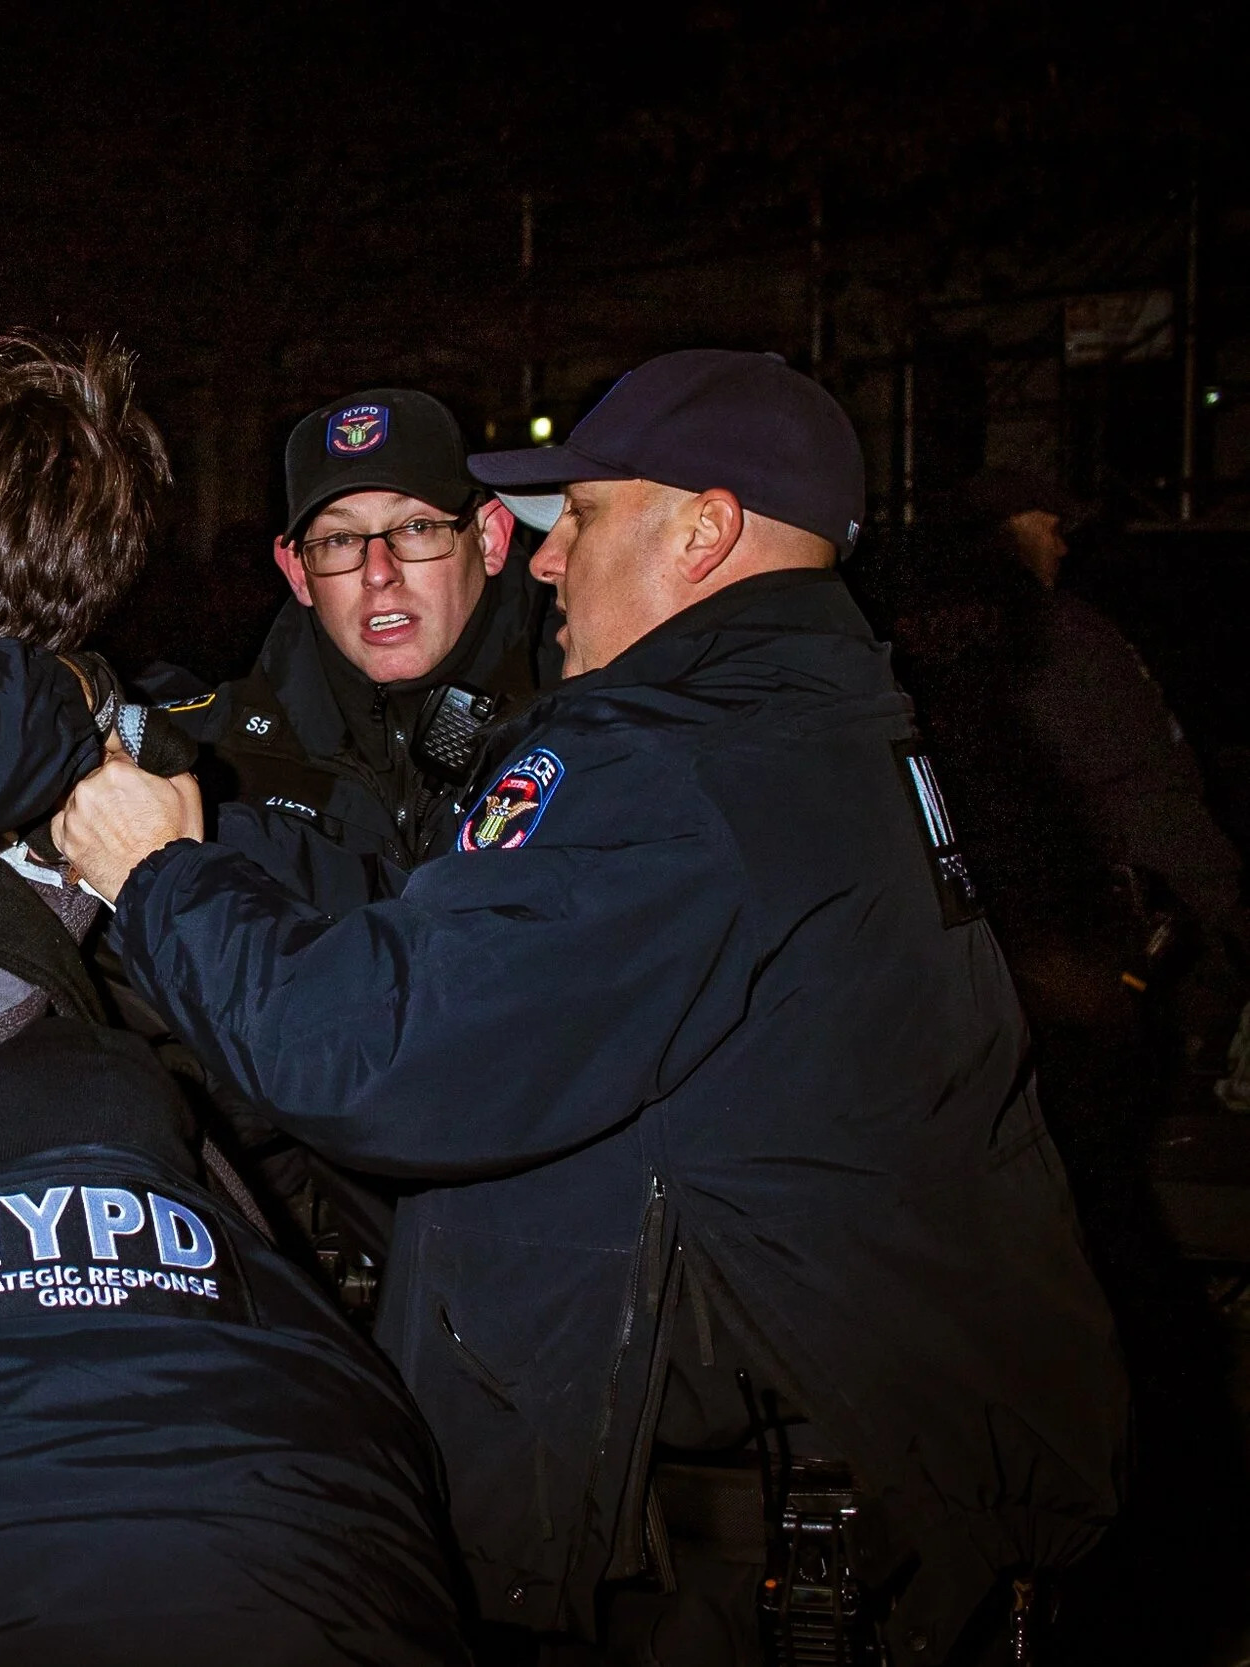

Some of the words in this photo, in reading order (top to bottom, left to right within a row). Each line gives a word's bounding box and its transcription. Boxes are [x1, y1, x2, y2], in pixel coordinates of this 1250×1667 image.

[342, 406, 379, 419] NYPD
[245, 716, 272, 735] S5
[88, 1266, 220, 1300] RESPONSE
[37, 1287, 129, 1308] GROUP
